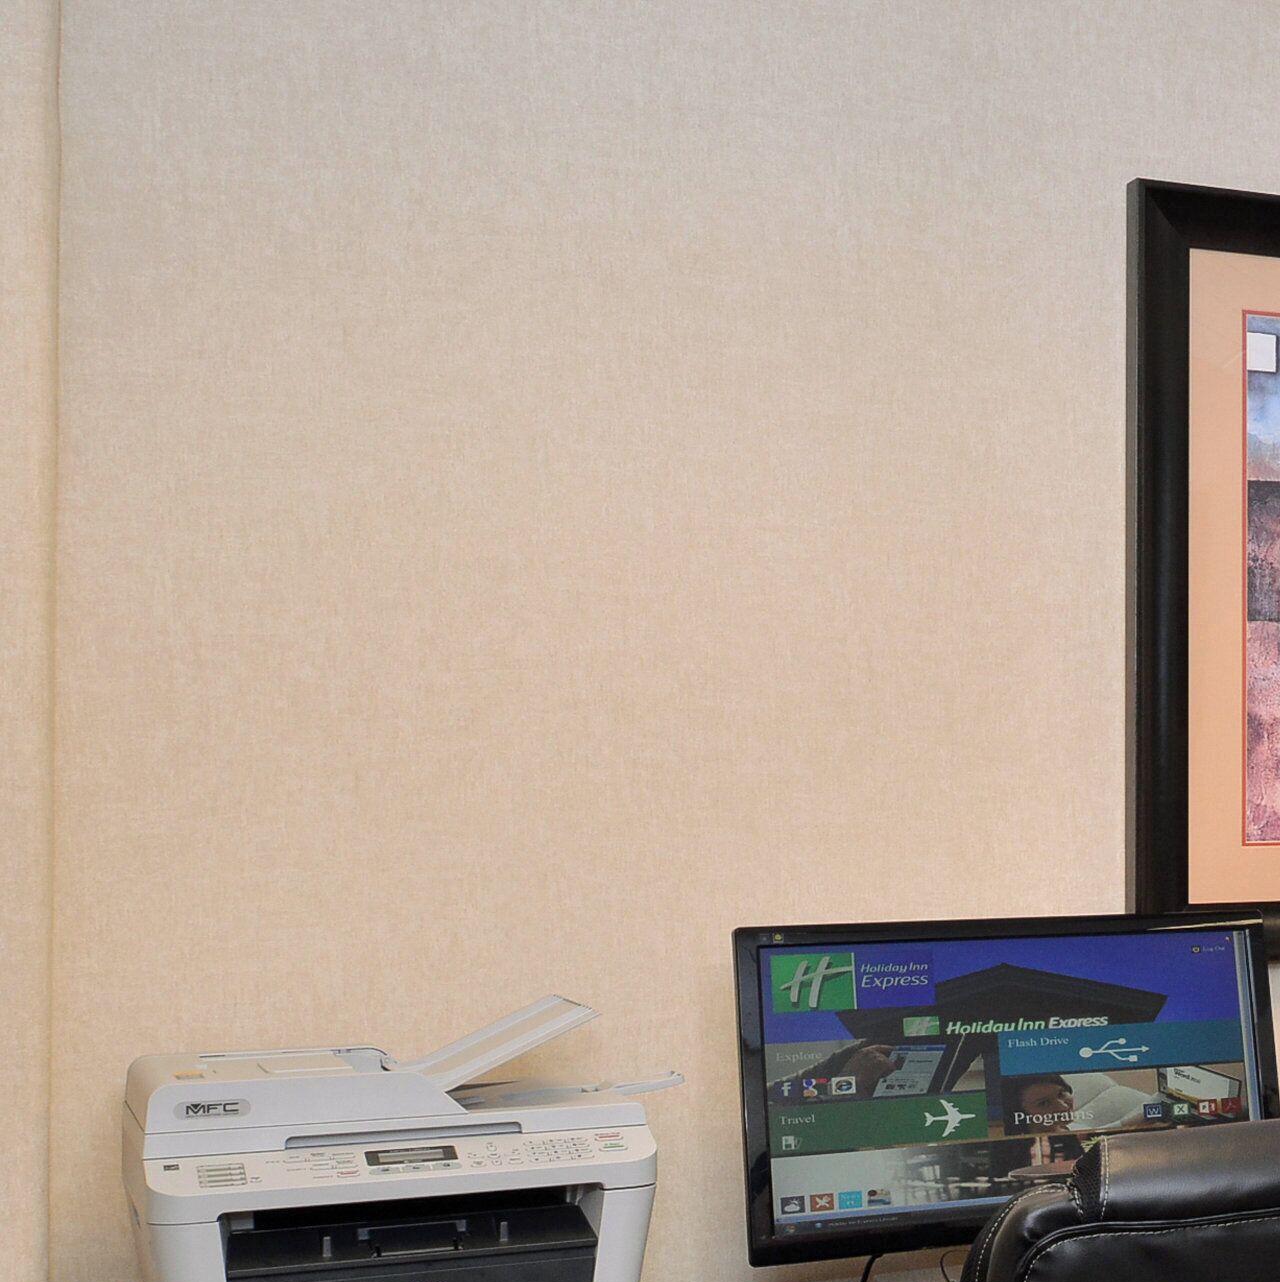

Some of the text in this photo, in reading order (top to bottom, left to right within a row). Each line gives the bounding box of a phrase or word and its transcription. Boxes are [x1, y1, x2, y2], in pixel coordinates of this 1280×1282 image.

[860, 962, 928, 974] Holiday Inn
[861, 974, 929, 990] Express
[1017, 1017, 1045, 1031] Inn
[1007, 1036, 1069, 1049] Flash Drive
[775, 1051, 822, 1064] Explore
[185, 1102, 240, 1116] MFC
[779, 1113, 816, 1126] Travel
[1013, 1109, 1094, 1126] Programs
